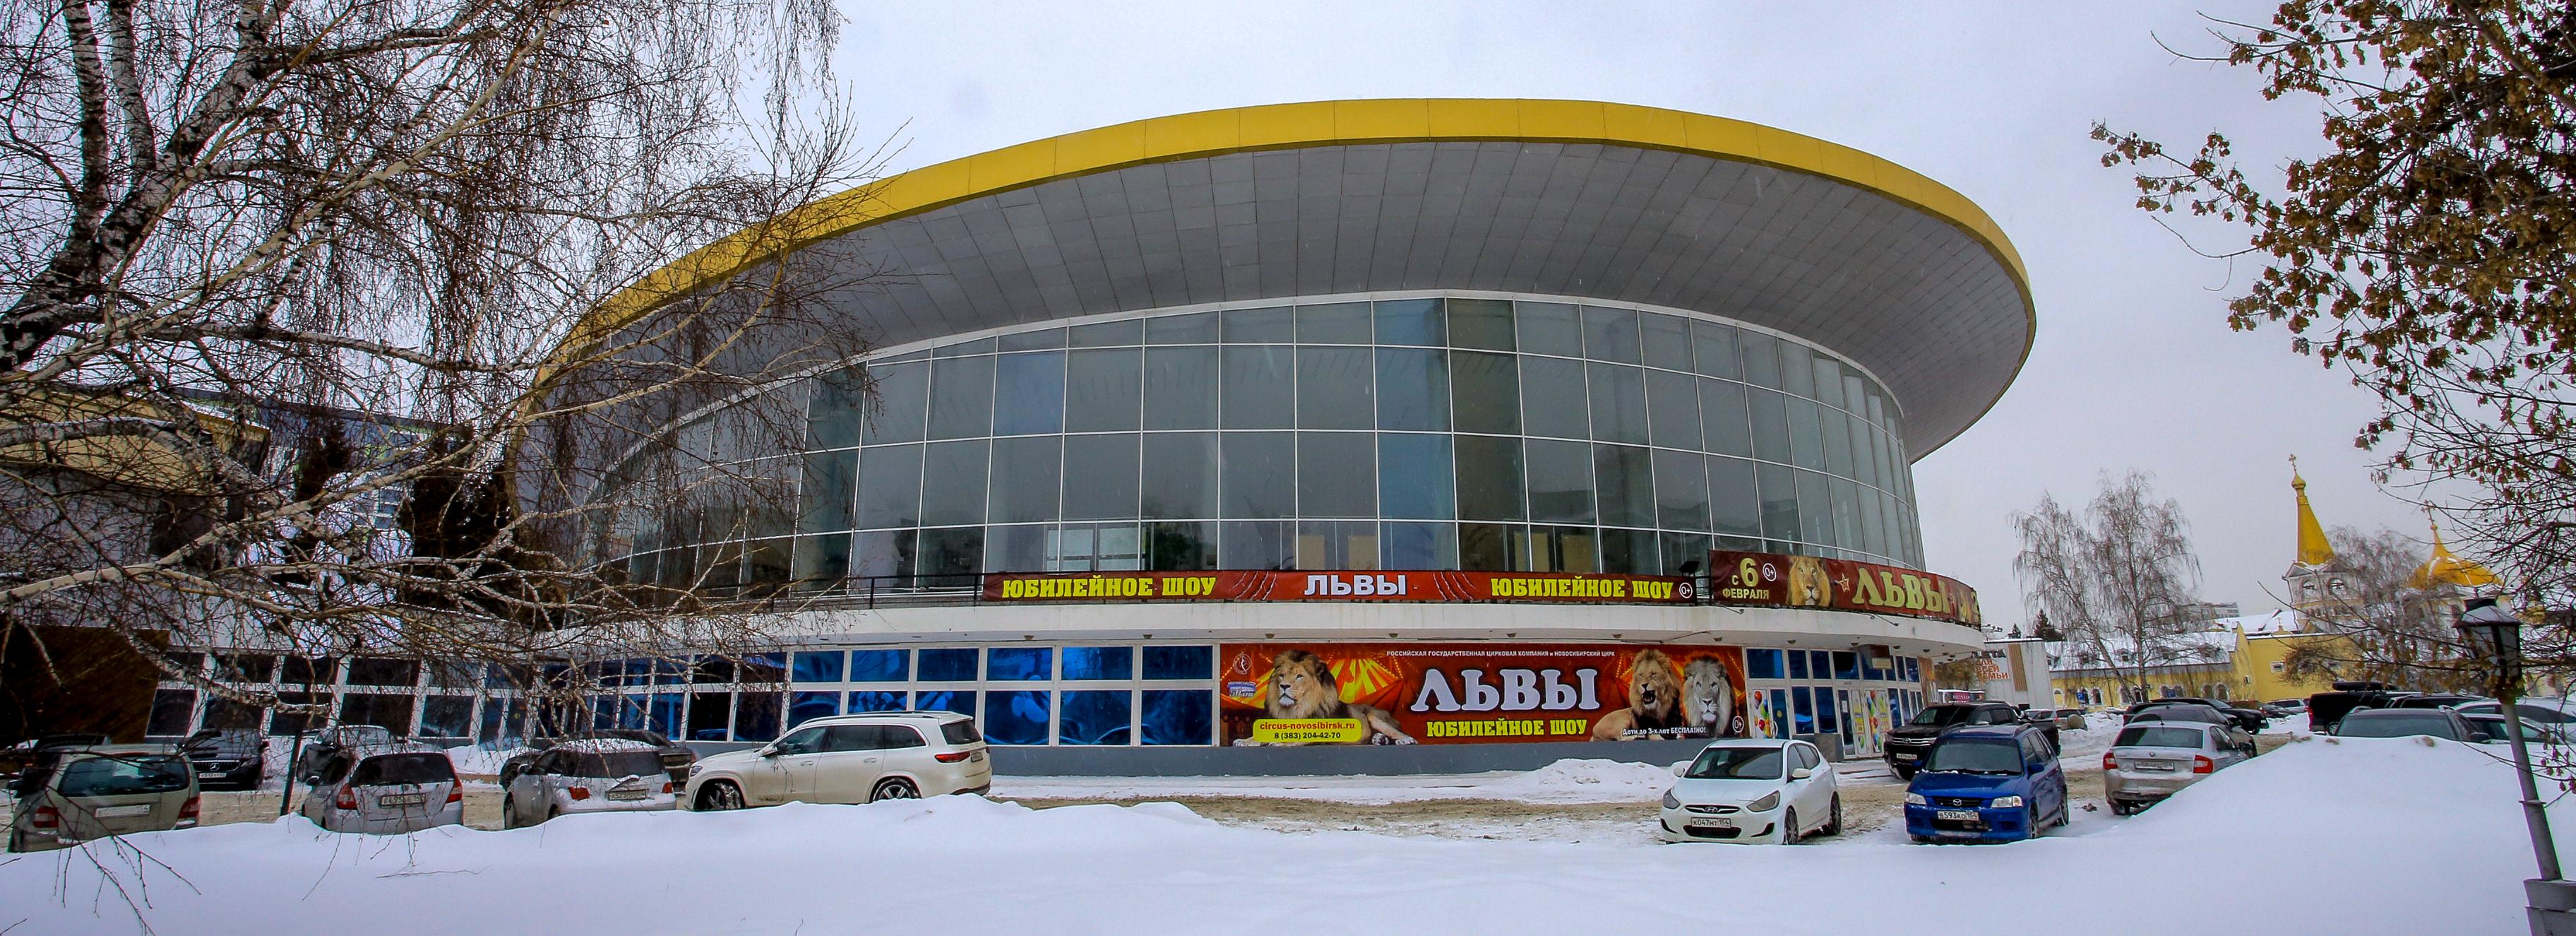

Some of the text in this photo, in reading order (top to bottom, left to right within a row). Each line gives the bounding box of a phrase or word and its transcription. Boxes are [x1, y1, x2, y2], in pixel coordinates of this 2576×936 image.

[1739, 557, 1759, 587] 6
[1002, 575, 1217, 598] ЮБИЛЕЙНОЕ ШОУ
[1304, 574, 1406, 596] ЛЬВЫ
[1491, 575, 1674, 599] ЮБИЛЕЙНОЕ ШОУ
[1722, 588, 1770, 599] ФЕВРАЛЯ
[1852, 567, 1950, 614] ЛЬВЫ
[1410, 668, 1600, 711] ЛЬВЫ
[1426, 718, 1587, 737] ЮБИЛЕЙНОЕ ШОУ
